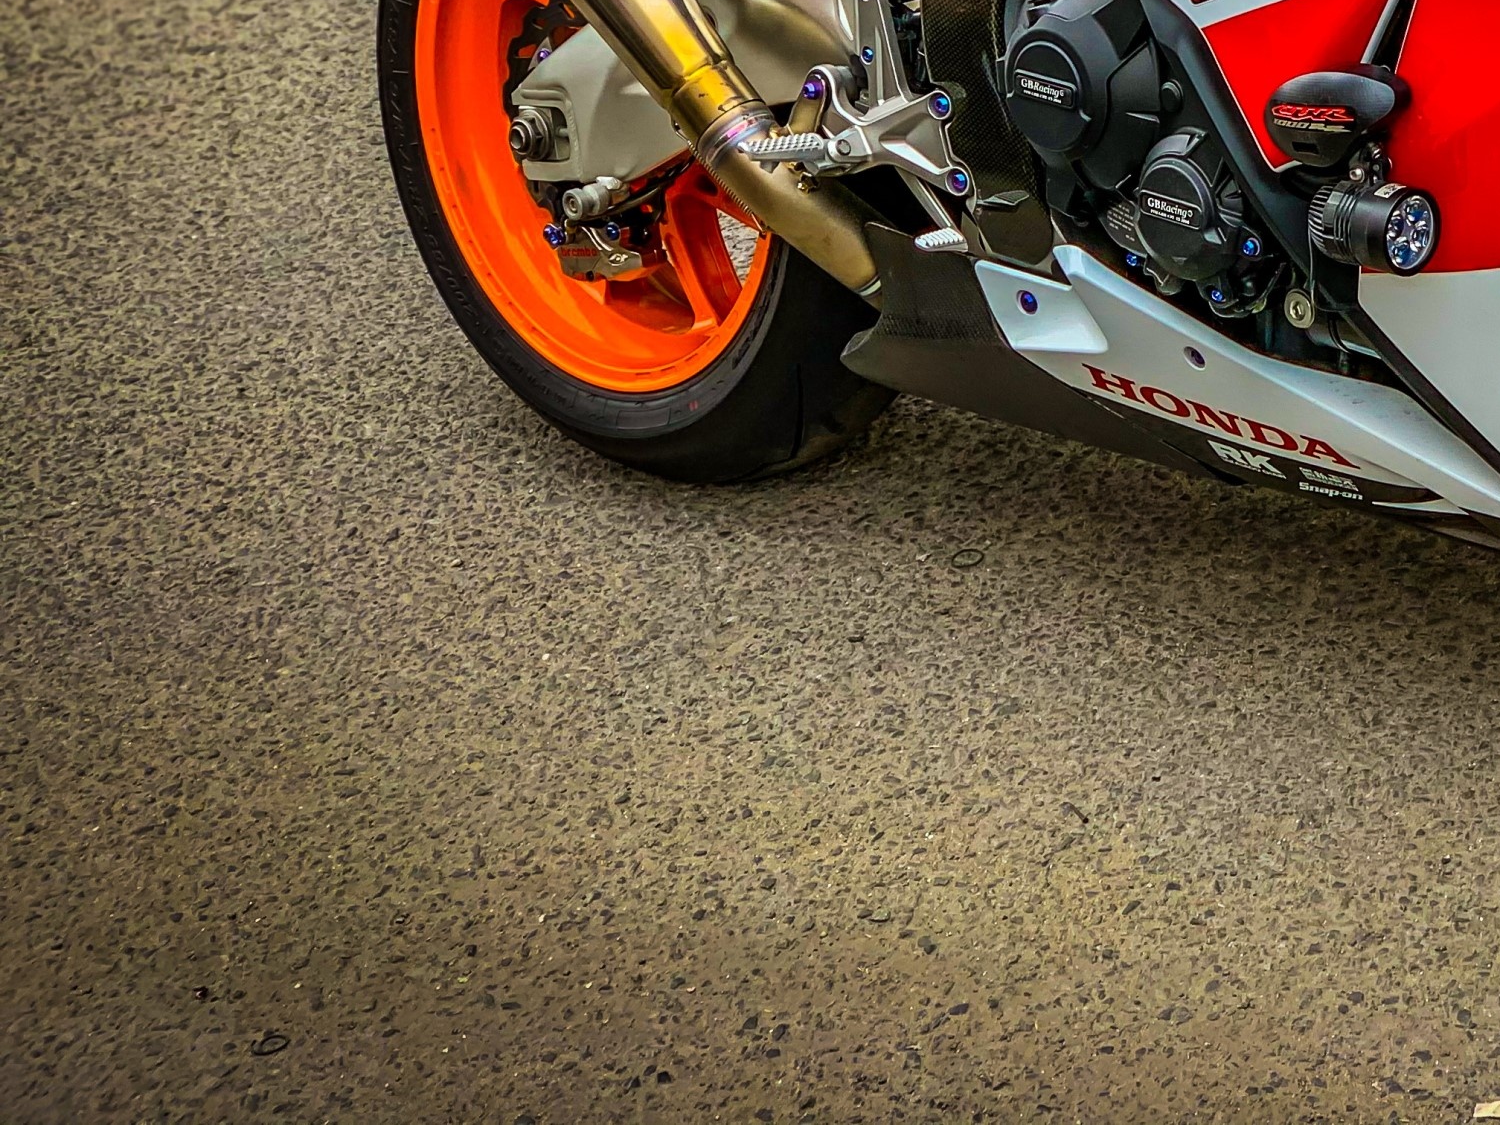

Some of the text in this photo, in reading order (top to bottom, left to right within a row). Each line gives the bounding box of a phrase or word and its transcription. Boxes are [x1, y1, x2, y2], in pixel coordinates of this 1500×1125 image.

[1021, 78, 1060, 98] GBRacing
[1147, 197, 1187, 218] GBRacing
[1081, 363, 1361, 469] HONDA
[1207, 440, 1282, 475] RK
